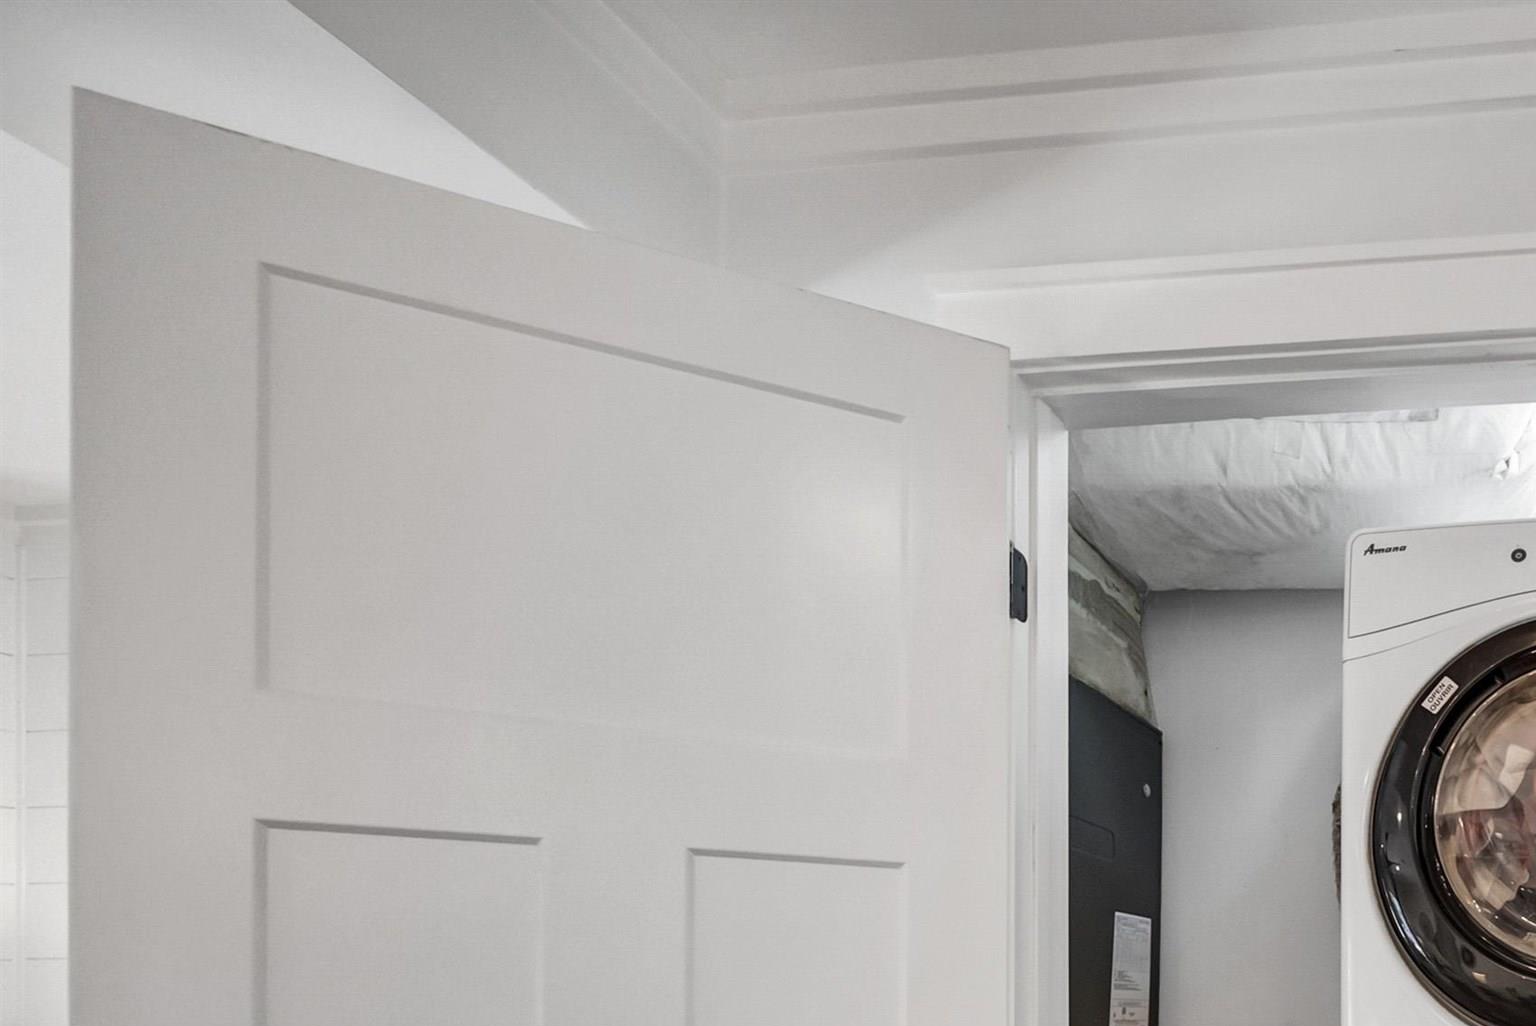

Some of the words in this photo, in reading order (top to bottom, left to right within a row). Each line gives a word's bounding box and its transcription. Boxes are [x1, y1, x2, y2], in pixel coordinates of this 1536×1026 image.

[1363, 543, 1407, 556] Amana
[1427, 682, 1446, 703] OPEN
[1430, 683, 1454, 711] OUVRIR
